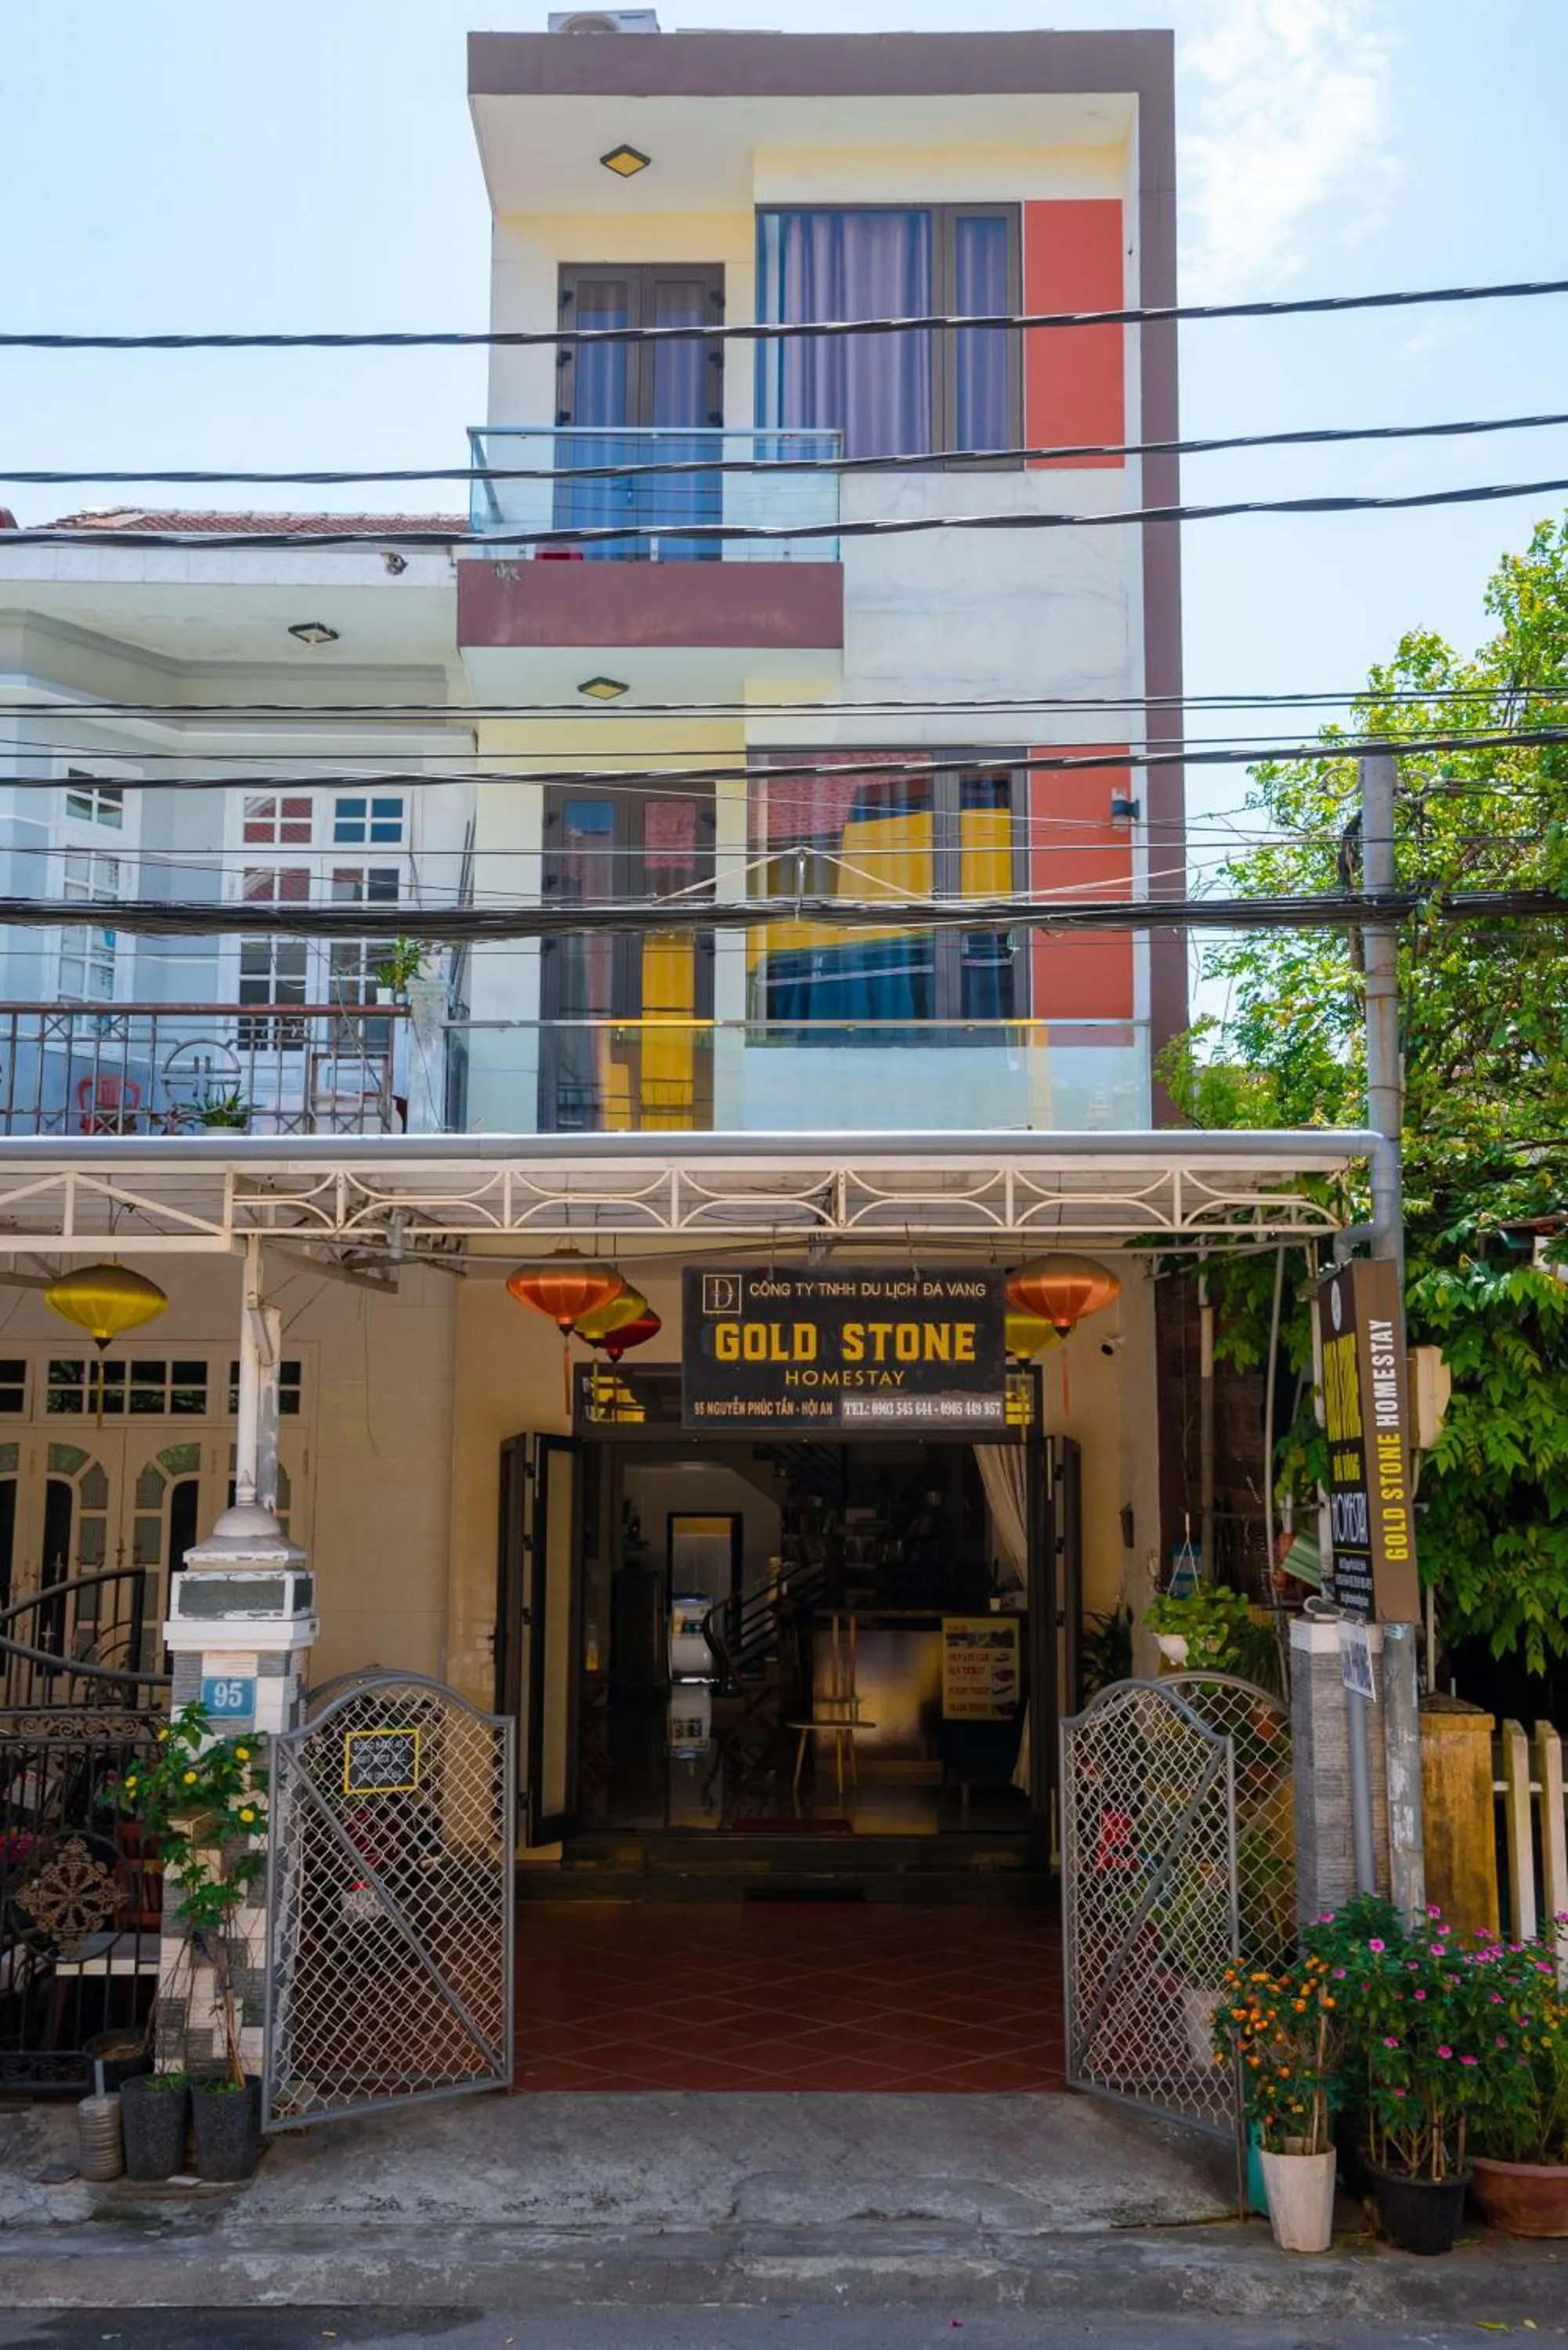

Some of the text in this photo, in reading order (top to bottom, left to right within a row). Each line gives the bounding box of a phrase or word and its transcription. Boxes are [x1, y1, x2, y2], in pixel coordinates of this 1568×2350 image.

[750, 1280, 791, 1297] CÔNG
[795, 1282, 814, 1296] TY
[818, 1282, 856, 1296] TNHH
[862, 1282, 881, 1296] DU
[715, 1322, 975, 1361] GOLD STONE
[785, 1369, 905, 1386] HOMESTAY
[844, 1401, 869, 1415] TEL:
[1369, 1319, 1409, 1560] GOLD STONE HOMESTAY
[214, 1681, 243, 1708] 95
